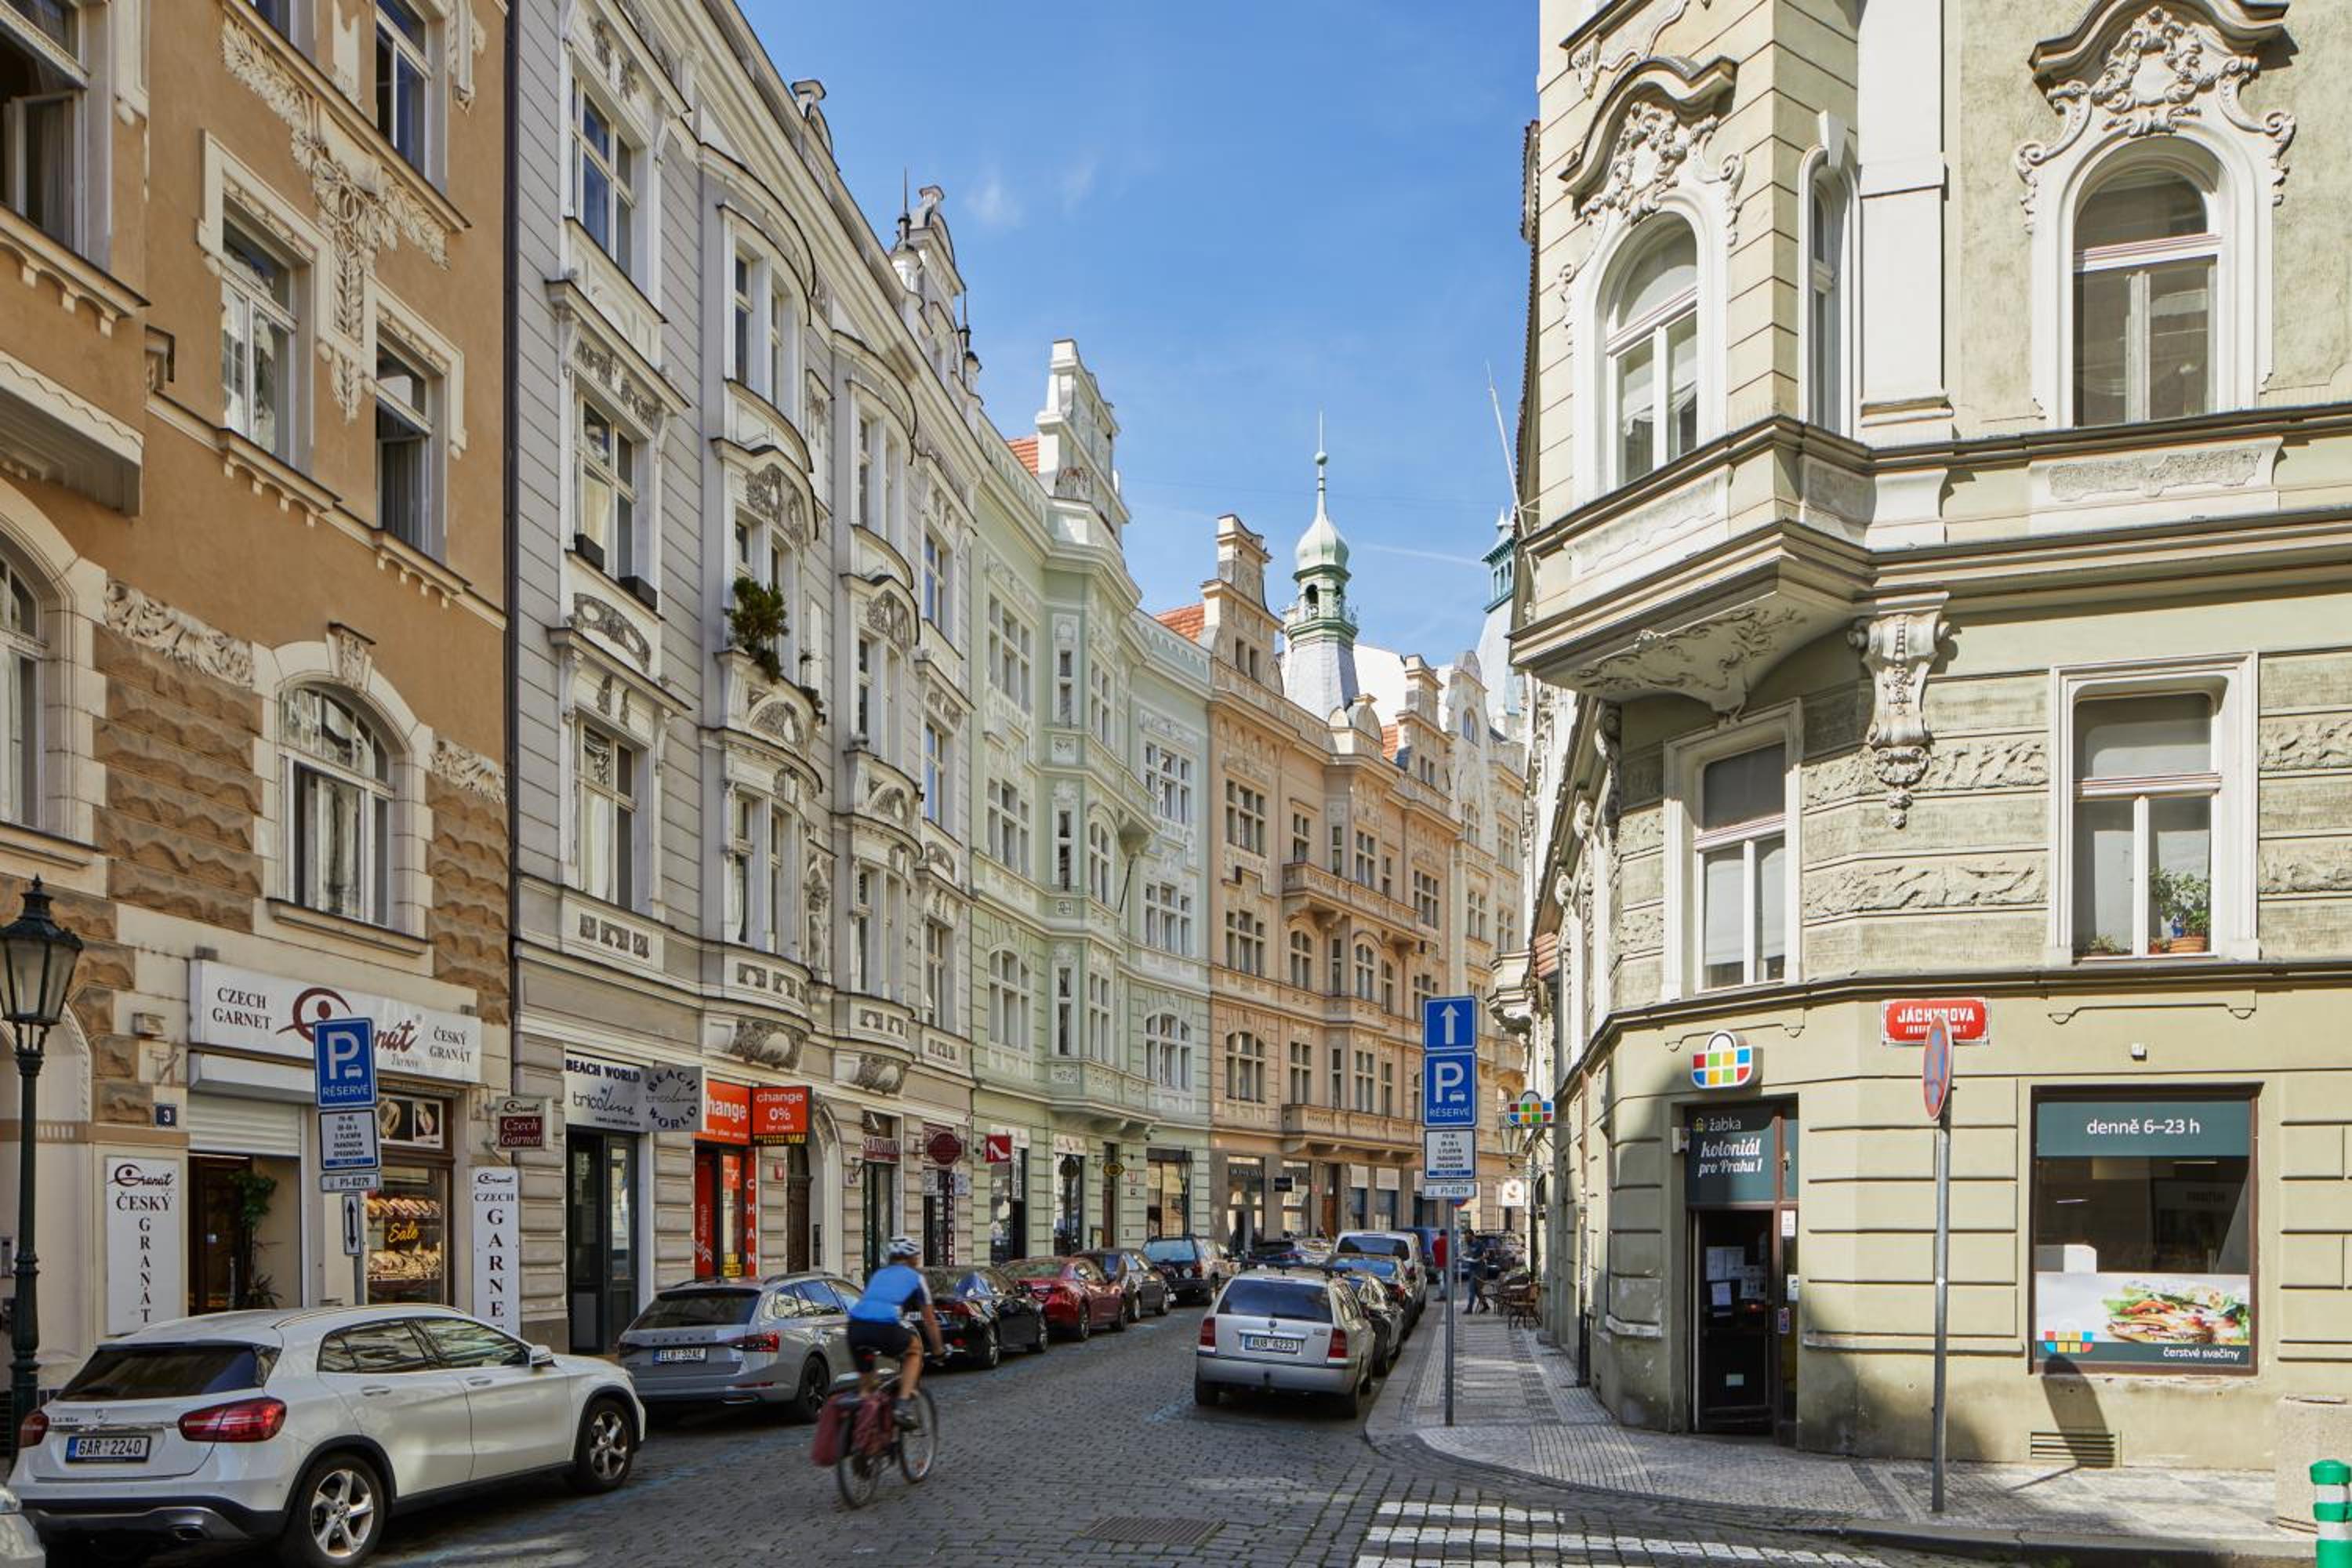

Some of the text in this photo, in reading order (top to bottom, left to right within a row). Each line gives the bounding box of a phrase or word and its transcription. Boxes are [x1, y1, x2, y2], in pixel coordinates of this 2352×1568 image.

[216, 987, 267, 1010] CZECH
[212, 1007, 272, 1030] GARNET
[434, 1025, 466, 1045] ČESKÝ
[327, 1031, 360, 1080] P
[429, 1045, 471, 1063] GRANÁT
[566, 1059, 641, 1083] BEACH WORLD
[647, 1069, 697, 1093] BEACH
[1434, 1062, 1465, 1103] P
[757, 1092, 804, 1104] change
[164, 1109, 170, 1122] 3
[649, 1105, 698, 1129] WORLD
[769, 1107, 791, 1120] 0%
[1709, 1116, 1741, 1131] žabka
[504, 1119, 539, 1131] Czech
[2086, 1118, 2140, 1134] denně
[2189, 1118, 2201, 1134] h
[1700, 1138, 1762, 1158] koloniál
[1697, 1163, 1718, 1178] pro
[1719, 1159, 1755, 1174] Prahu
[116, 1191, 172, 1211] ČESKÝ
[474, 1192, 514, 1202] CZECH
[388, 1220, 419, 1243] Sale
[139, 1216, 151, 1323] GRANÁT
[487, 1208, 504, 1329] GARNE
[2164, 1346, 2241, 1362] čerstvé svačiny
[78, 1439, 142, 1455] 6AR 2240
